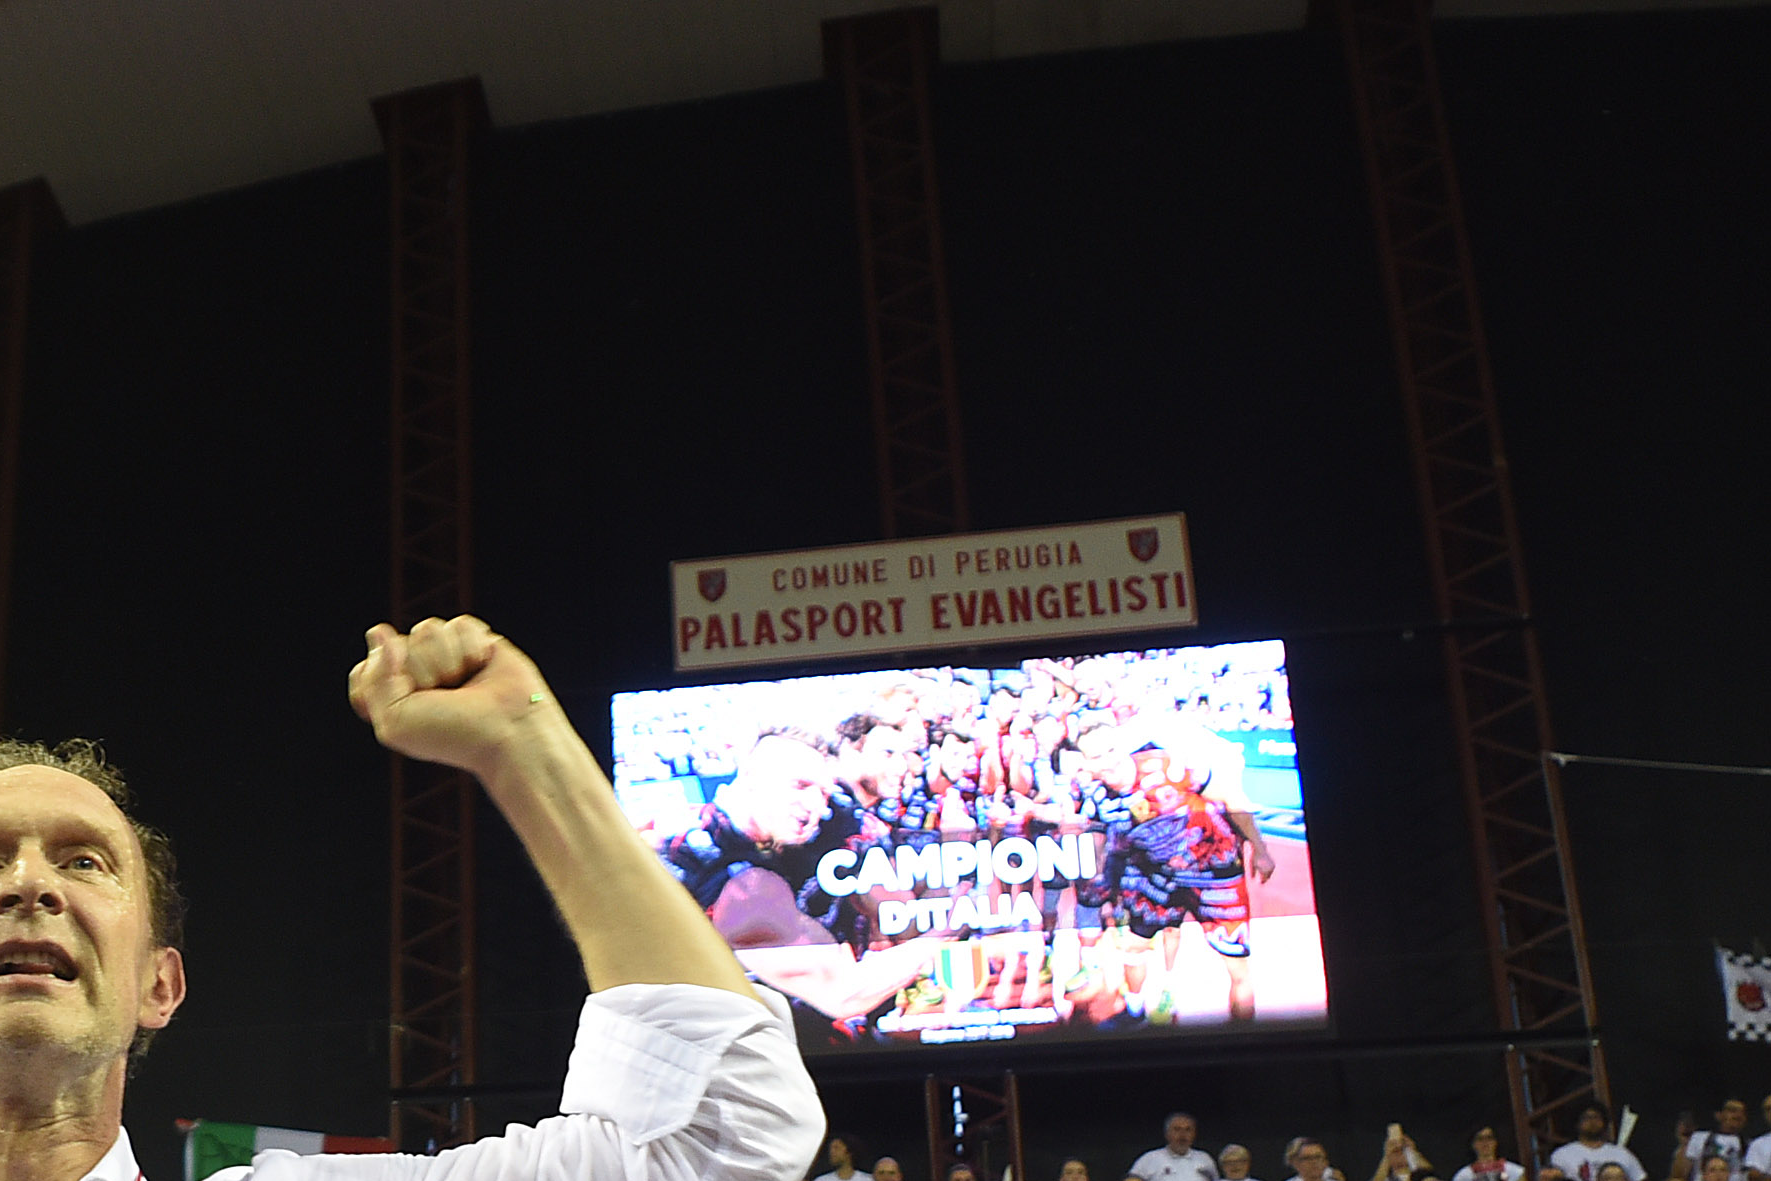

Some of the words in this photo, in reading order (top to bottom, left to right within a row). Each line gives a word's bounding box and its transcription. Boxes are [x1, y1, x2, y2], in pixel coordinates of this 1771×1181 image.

[773, 558, 887, 592] COMUNE
[909, 554, 936, 579] DI
[957, 541, 1083, 576] PERUGIA
[680, 596, 906, 653] PALASPORT
[932, 571, 1189, 630] EVANGELISTI
[816, 832, 1097, 897] CAMPIONI
[878, 891, 1043, 935] D'ITALIA
